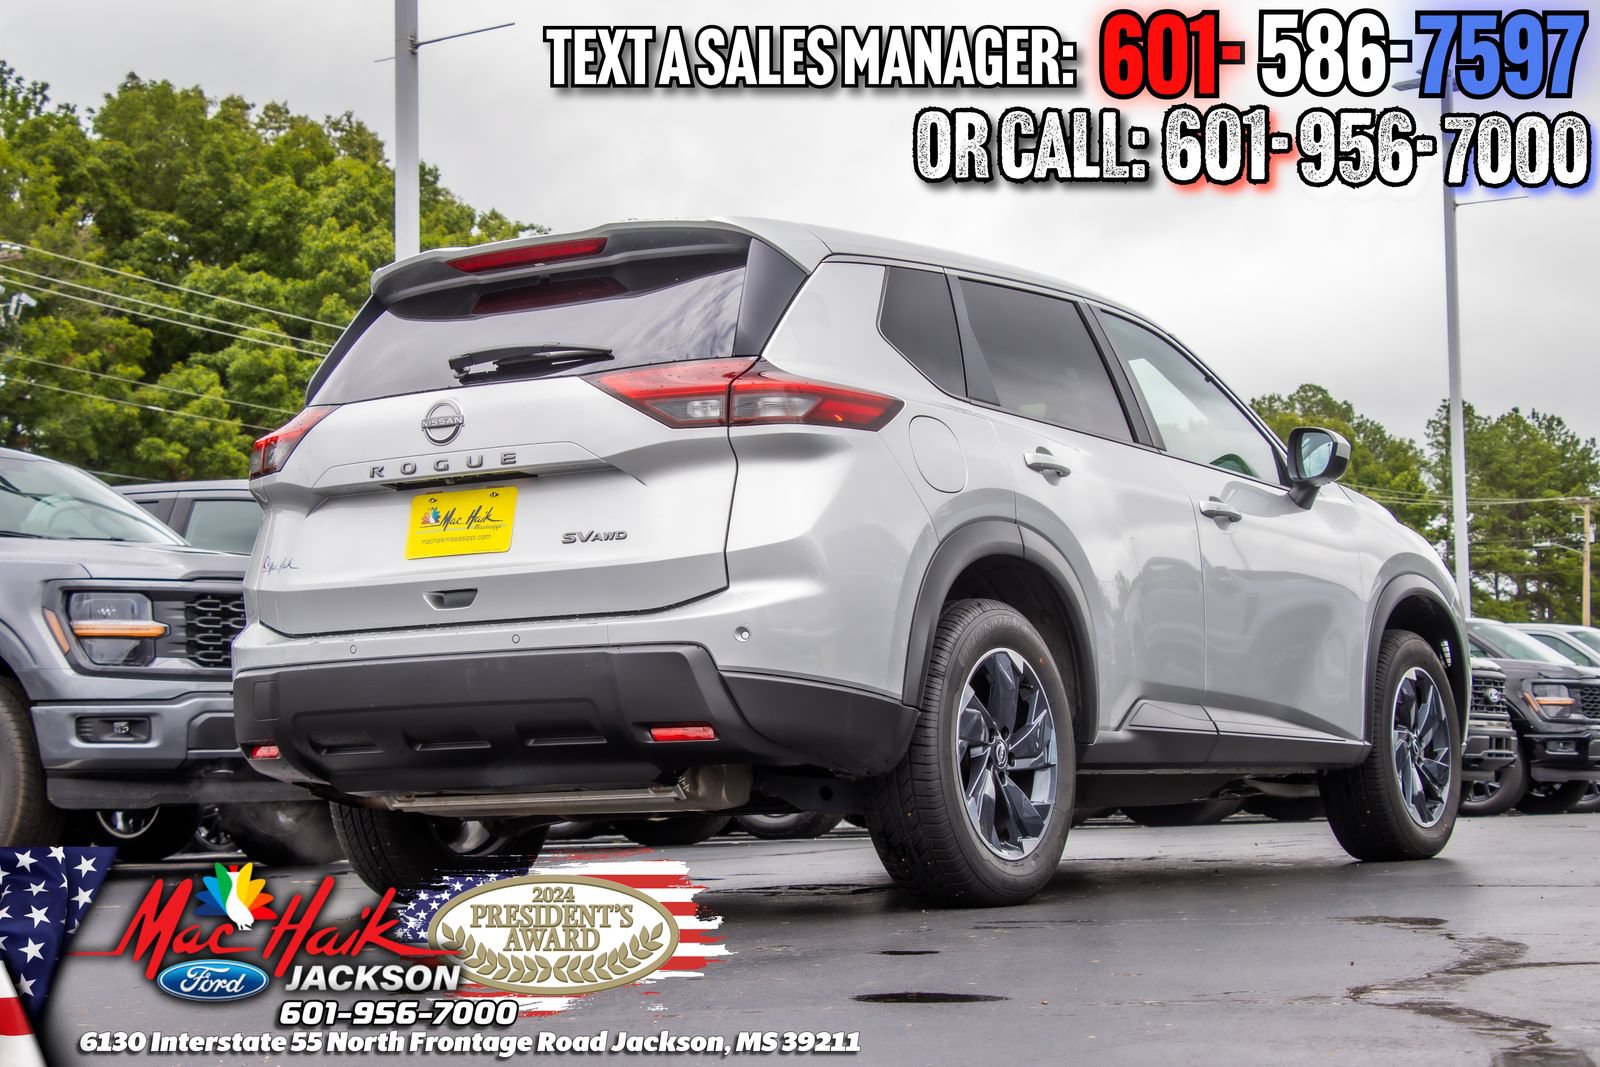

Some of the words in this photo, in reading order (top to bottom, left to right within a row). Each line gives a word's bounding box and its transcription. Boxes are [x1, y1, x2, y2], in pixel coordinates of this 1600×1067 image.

[422, 416, 463, 428] NISSAN
[369, 452, 517, 479] ROGUE
[438, 507, 464, 532] Mac
[465, 505, 503, 530] Haik
